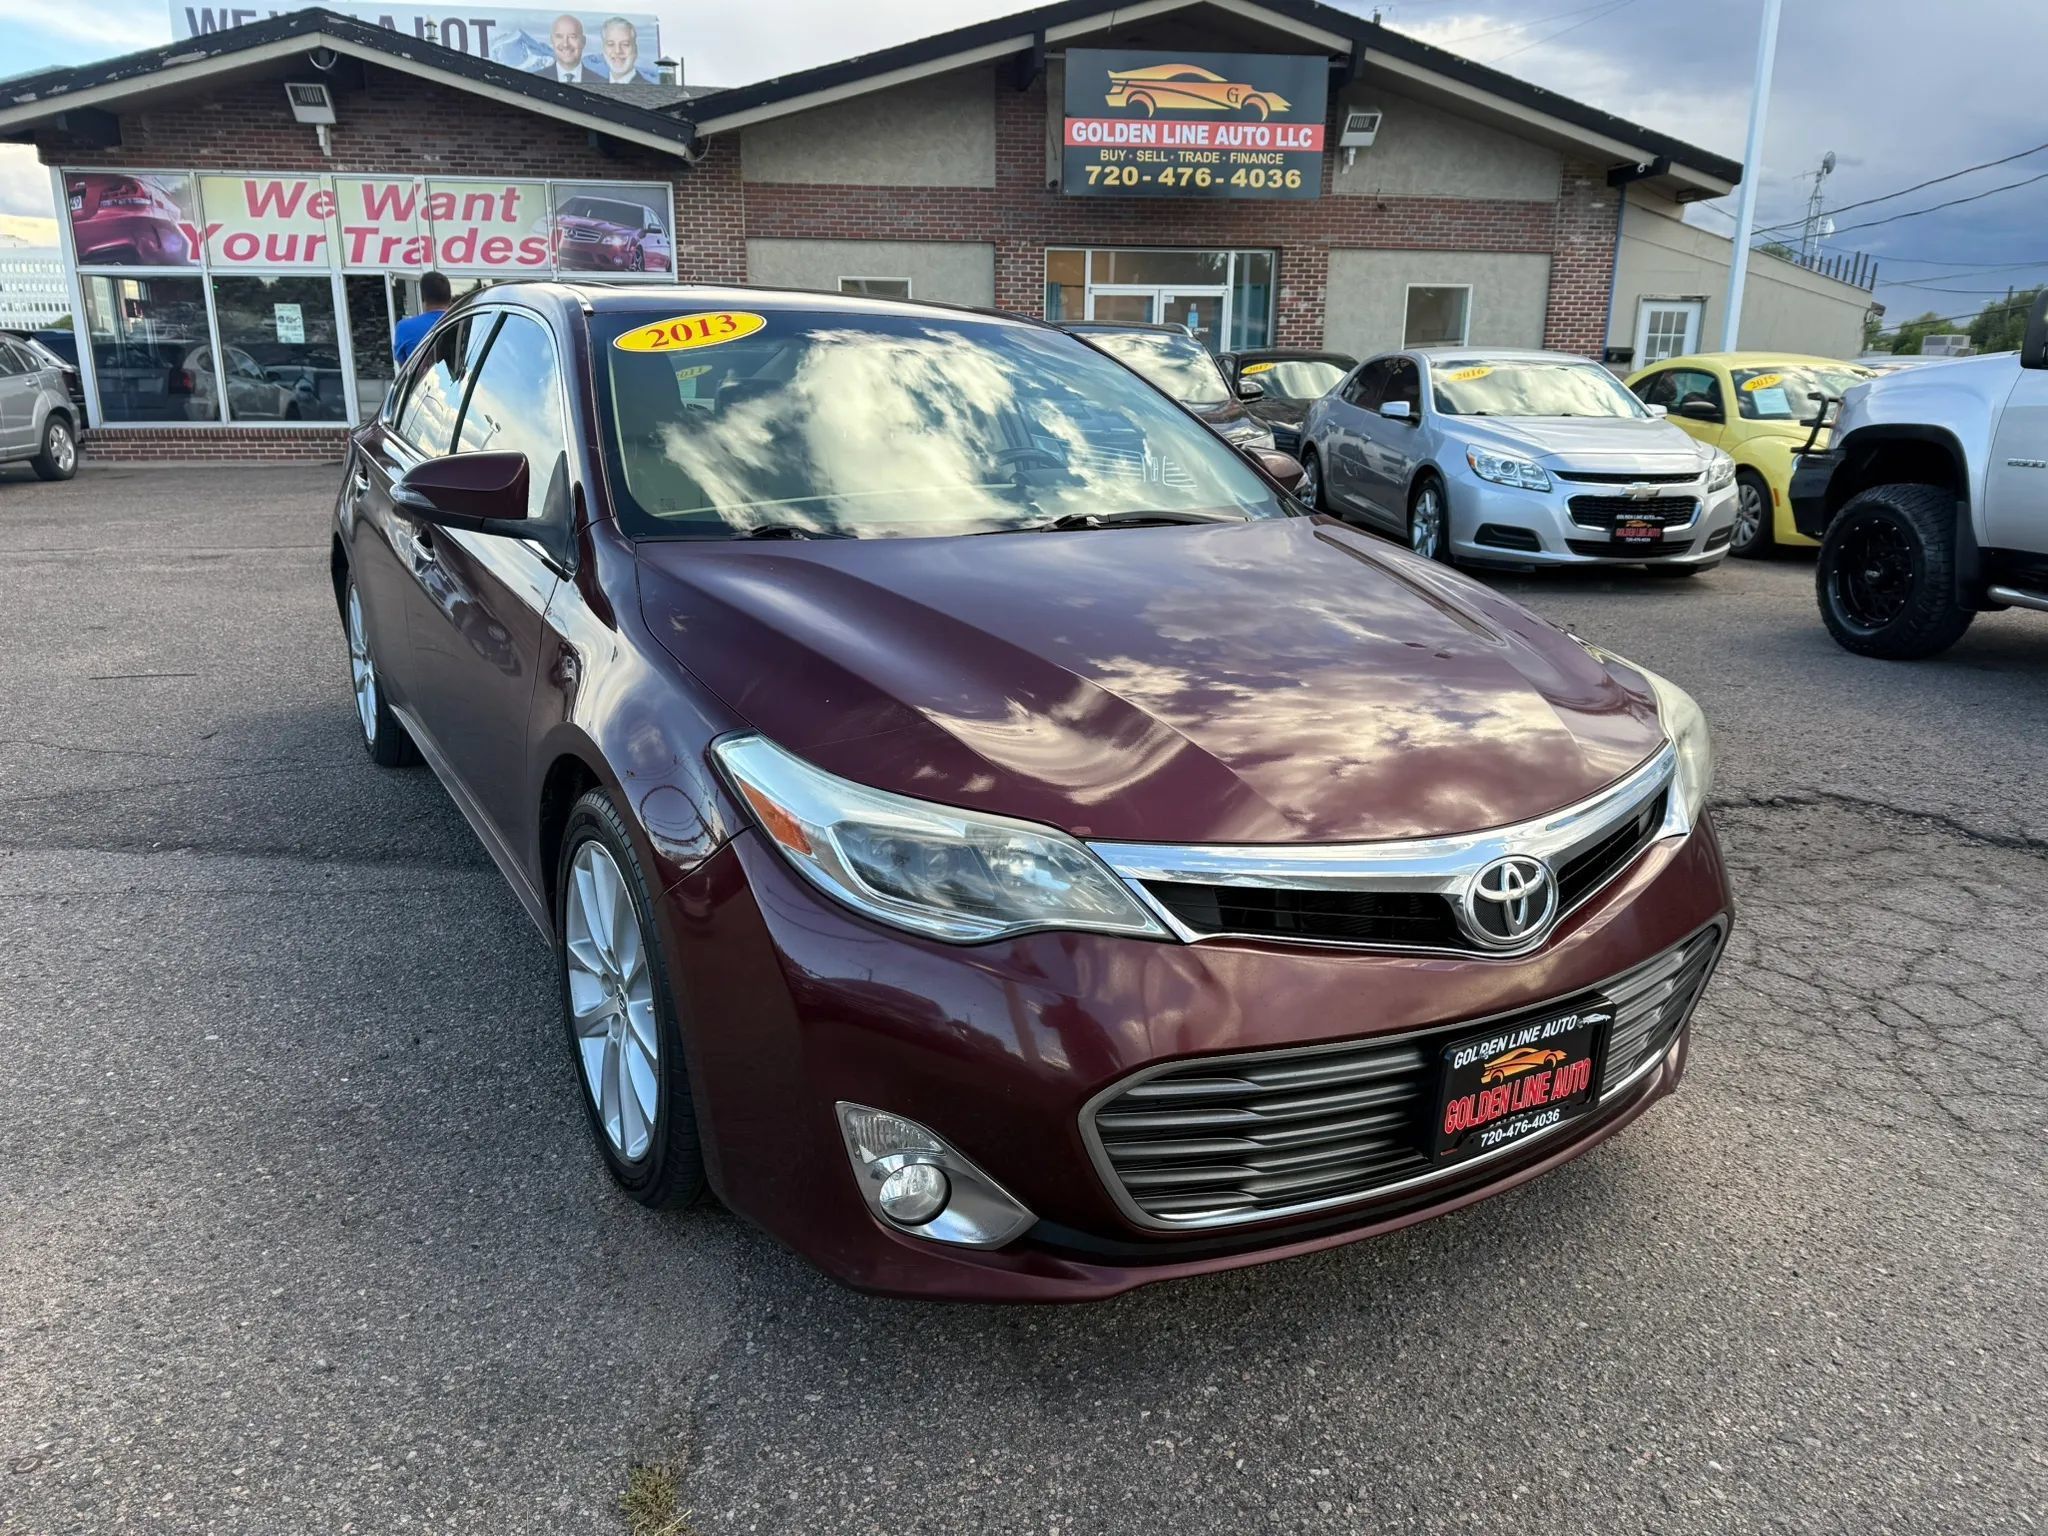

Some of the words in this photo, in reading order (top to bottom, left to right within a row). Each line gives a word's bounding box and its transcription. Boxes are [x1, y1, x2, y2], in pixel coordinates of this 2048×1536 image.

[1072, 122, 1156, 144] GOLDEN
[1163, 125, 1209, 145] LINE
[1215, 126, 1270, 146] AUTO
[1276, 128, 1312, 147] LLC
[1100, 149, 1127, 162] BUY
[1136, 150, 1168, 162] SELL
[1178, 151, 1220, 163] TRADE
[1230, 152, 1284, 165] FINANCE
[244, 180, 336, 220] We
[361, 183, 524, 222] Want
[178, 223, 327, 262] Your
[344, 226, 564, 265] Trades!
[646, 314, 738, 348] 2013
[1750, 376, 1777, 389] 2015
[1454, 1036, 1507, 1069] GOLDEN
[1508, 1025, 1541, 1049] LINE
[1541, 1015, 1578, 1039] AUTO
[1445, 1082, 1512, 1134] GOLDEN
[1511, 1071, 1552, 1111] LINE
[1551, 1057, 1591, 1100] AUTO
[1481, 1108, 1560, 1147] 720-476-4036
